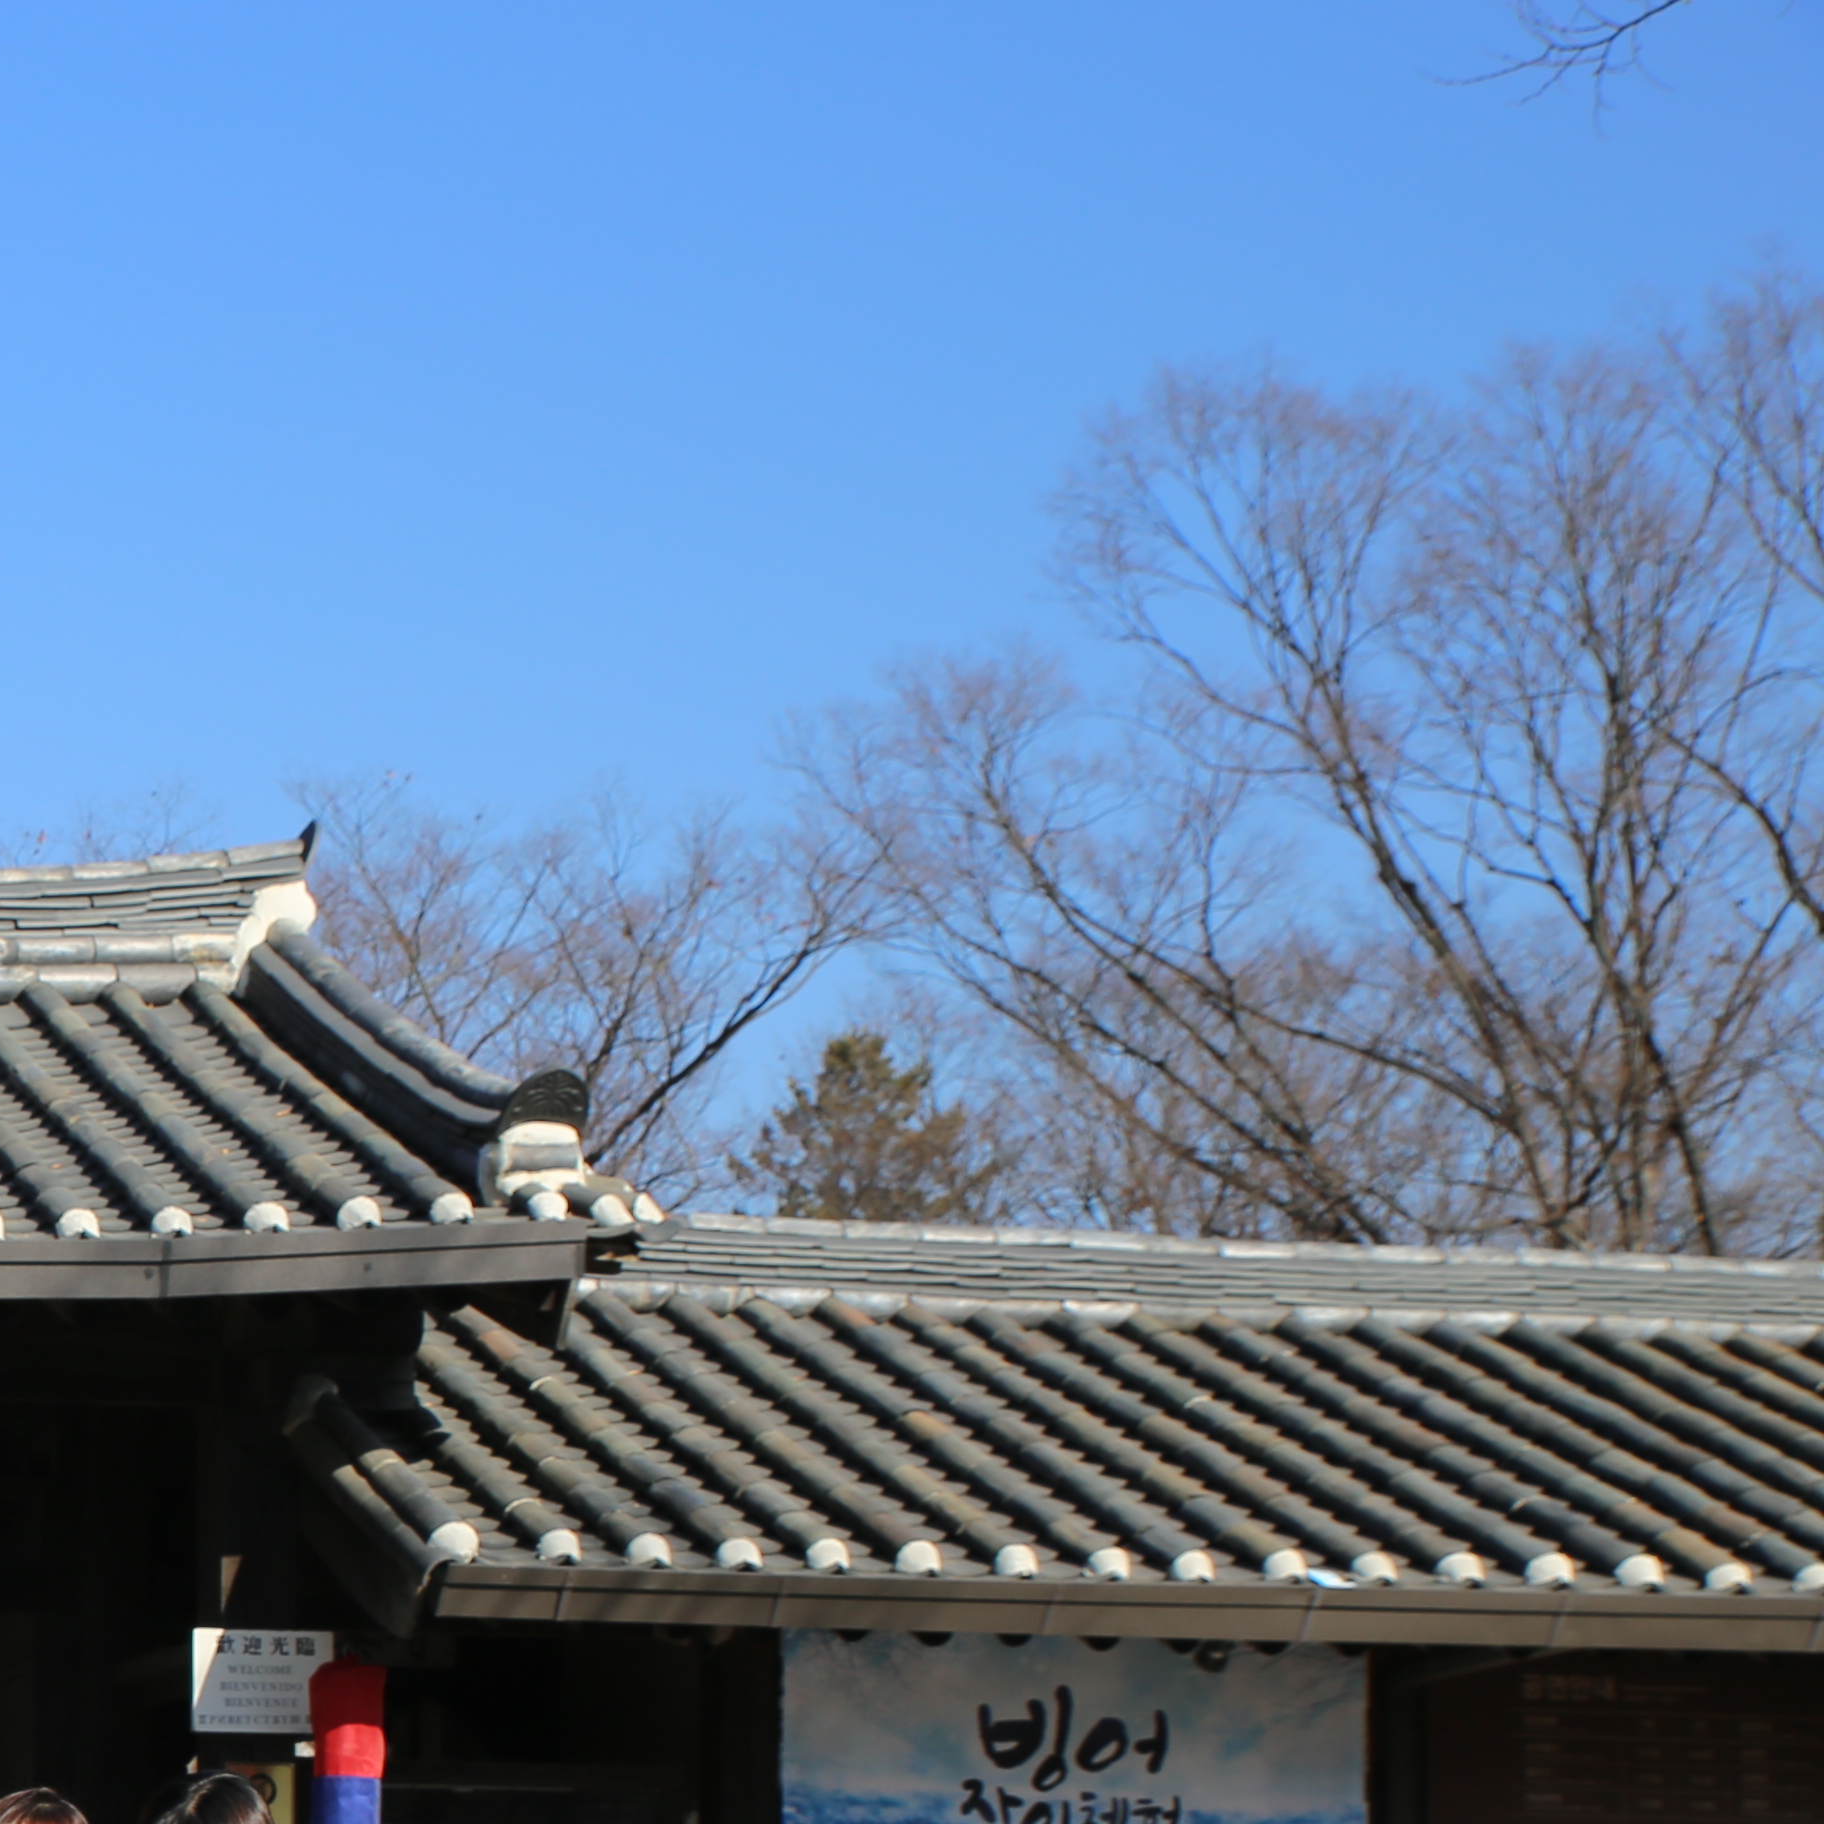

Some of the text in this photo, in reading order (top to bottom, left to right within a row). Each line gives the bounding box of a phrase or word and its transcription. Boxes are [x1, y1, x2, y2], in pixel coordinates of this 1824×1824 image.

[227, 1665, 292, 1675] WELCOME
[220, 1681, 303, 1692] BIENVENIDO
[224, 1698, 298, 1708] BIENVENUE
[977, 1685, 1170, 1791] 빙어
